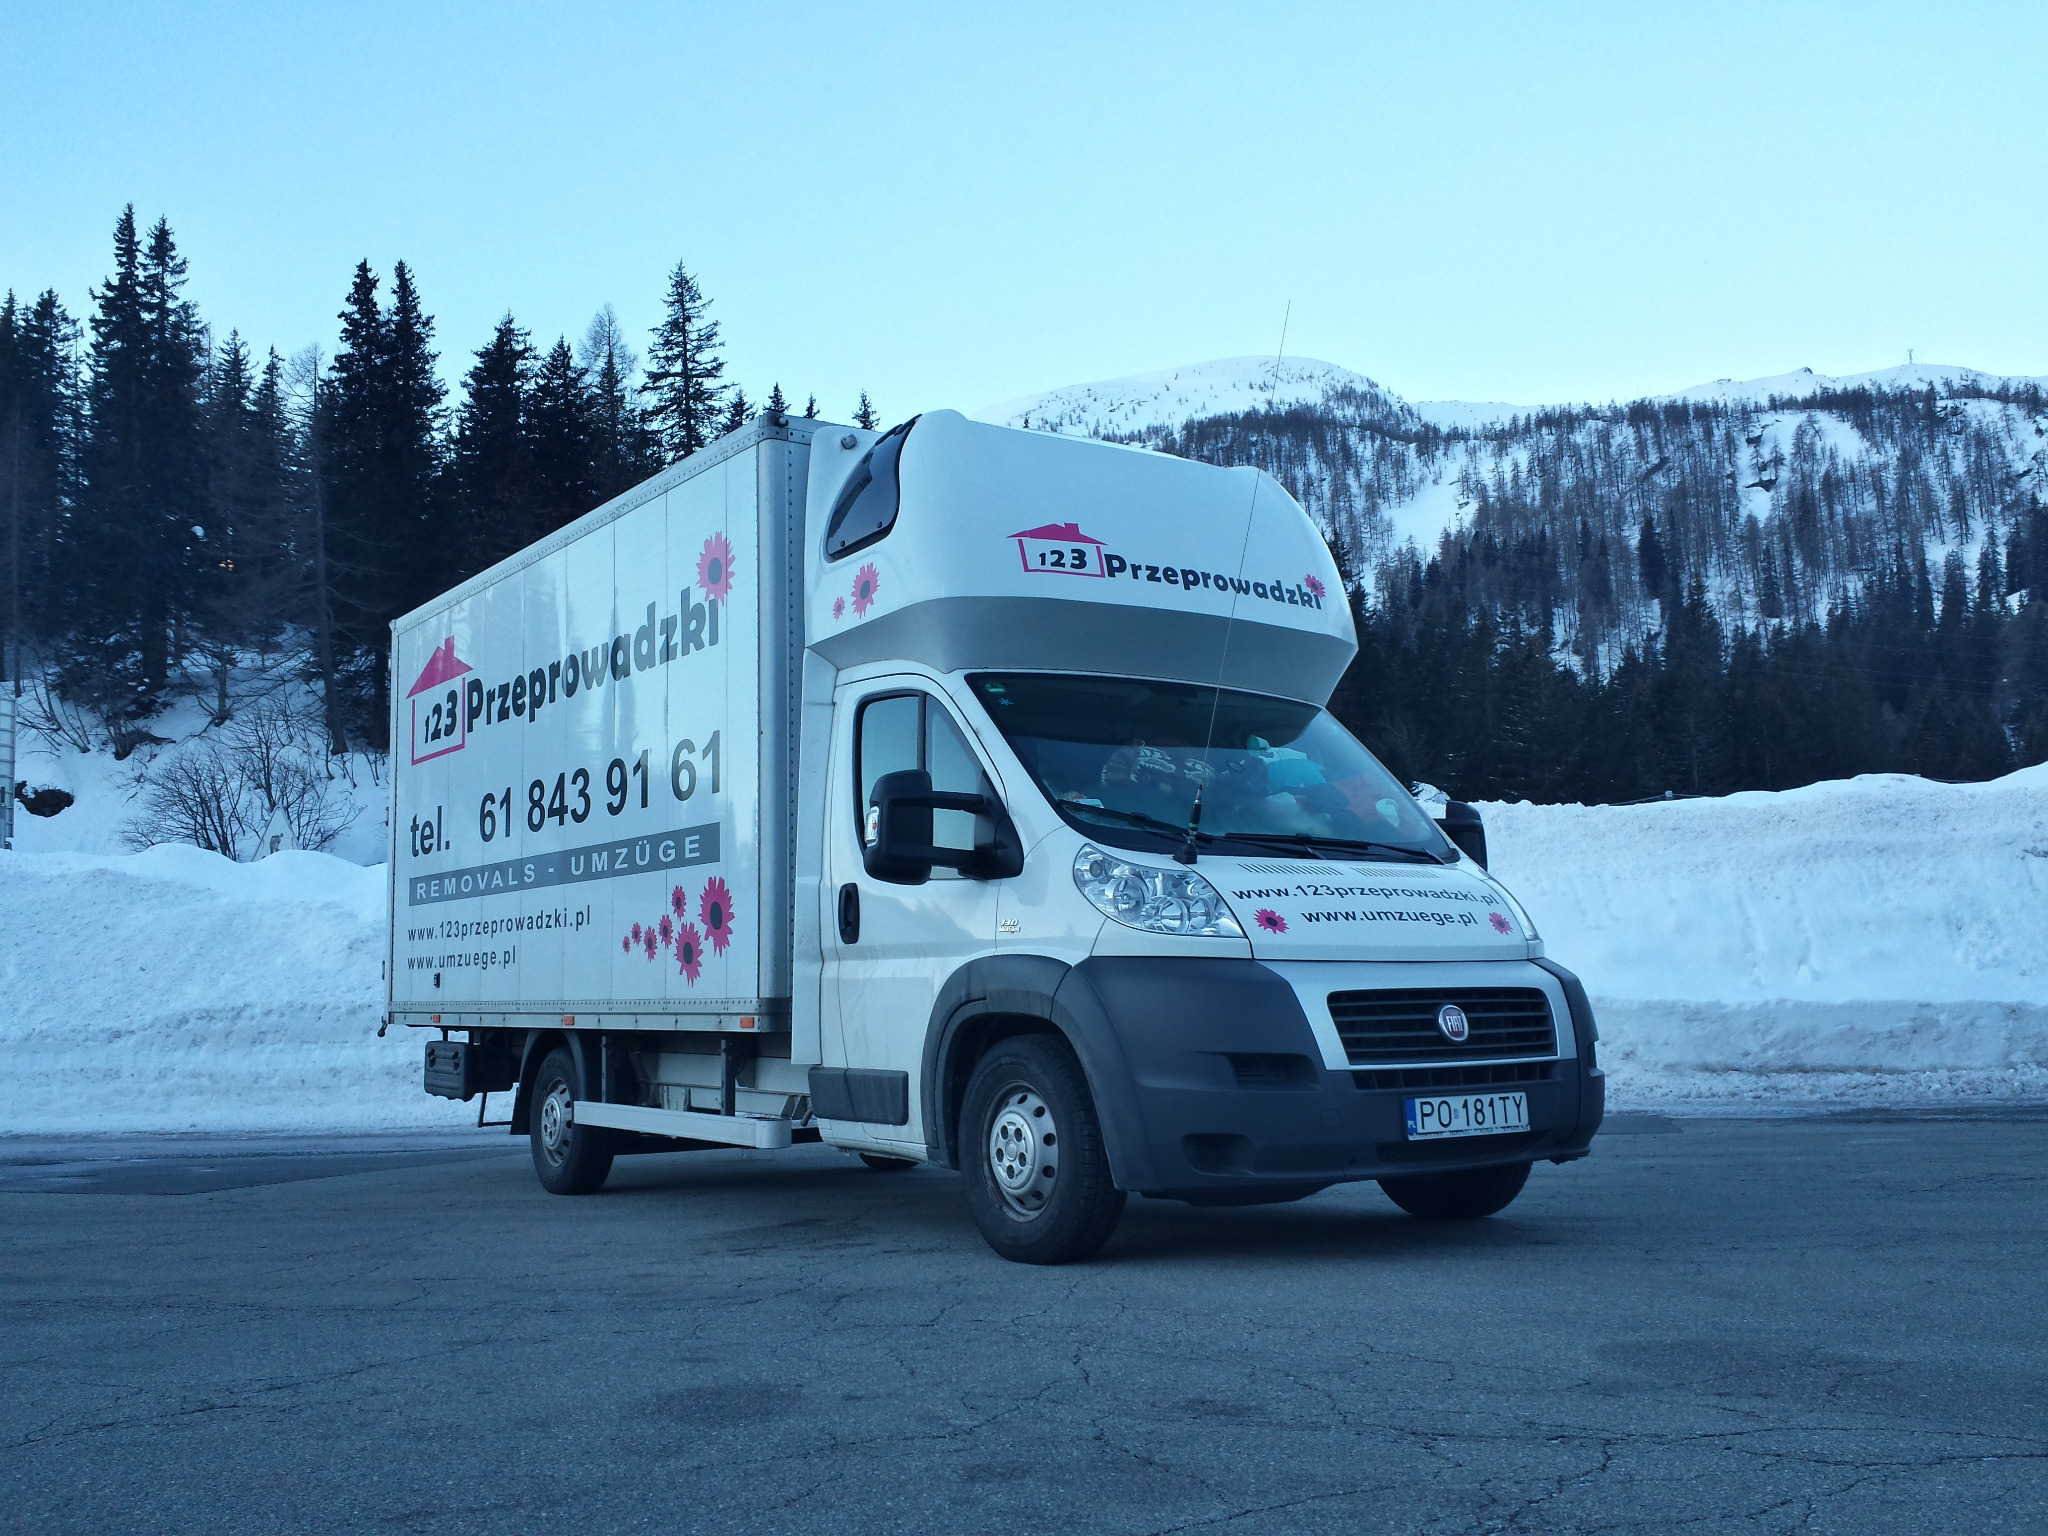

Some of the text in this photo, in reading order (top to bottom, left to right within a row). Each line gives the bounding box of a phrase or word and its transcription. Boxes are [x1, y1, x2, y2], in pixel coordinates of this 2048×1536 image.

[1038, 548, 1322, 610] 123 Przeprowadzki
[424, 586, 719, 744] 123 Przeprowadzki
[410, 729, 720, 857] tel. 61 843 91 61
[416, 863, 536, 900] REMOVALS
[571, 835, 701, 876] UMZÜGE
[1231, 884, 1499, 906] www.123przeprowadzki.pl
[407, 904, 591, 942] www.123przeprowadzki.pl
[1301, 908, 1478, 926] www.umzuege.pl
[407, 945, 516, 971] www.umzuege.pl
[1446, 1015, 1463, 1031] FIAT
